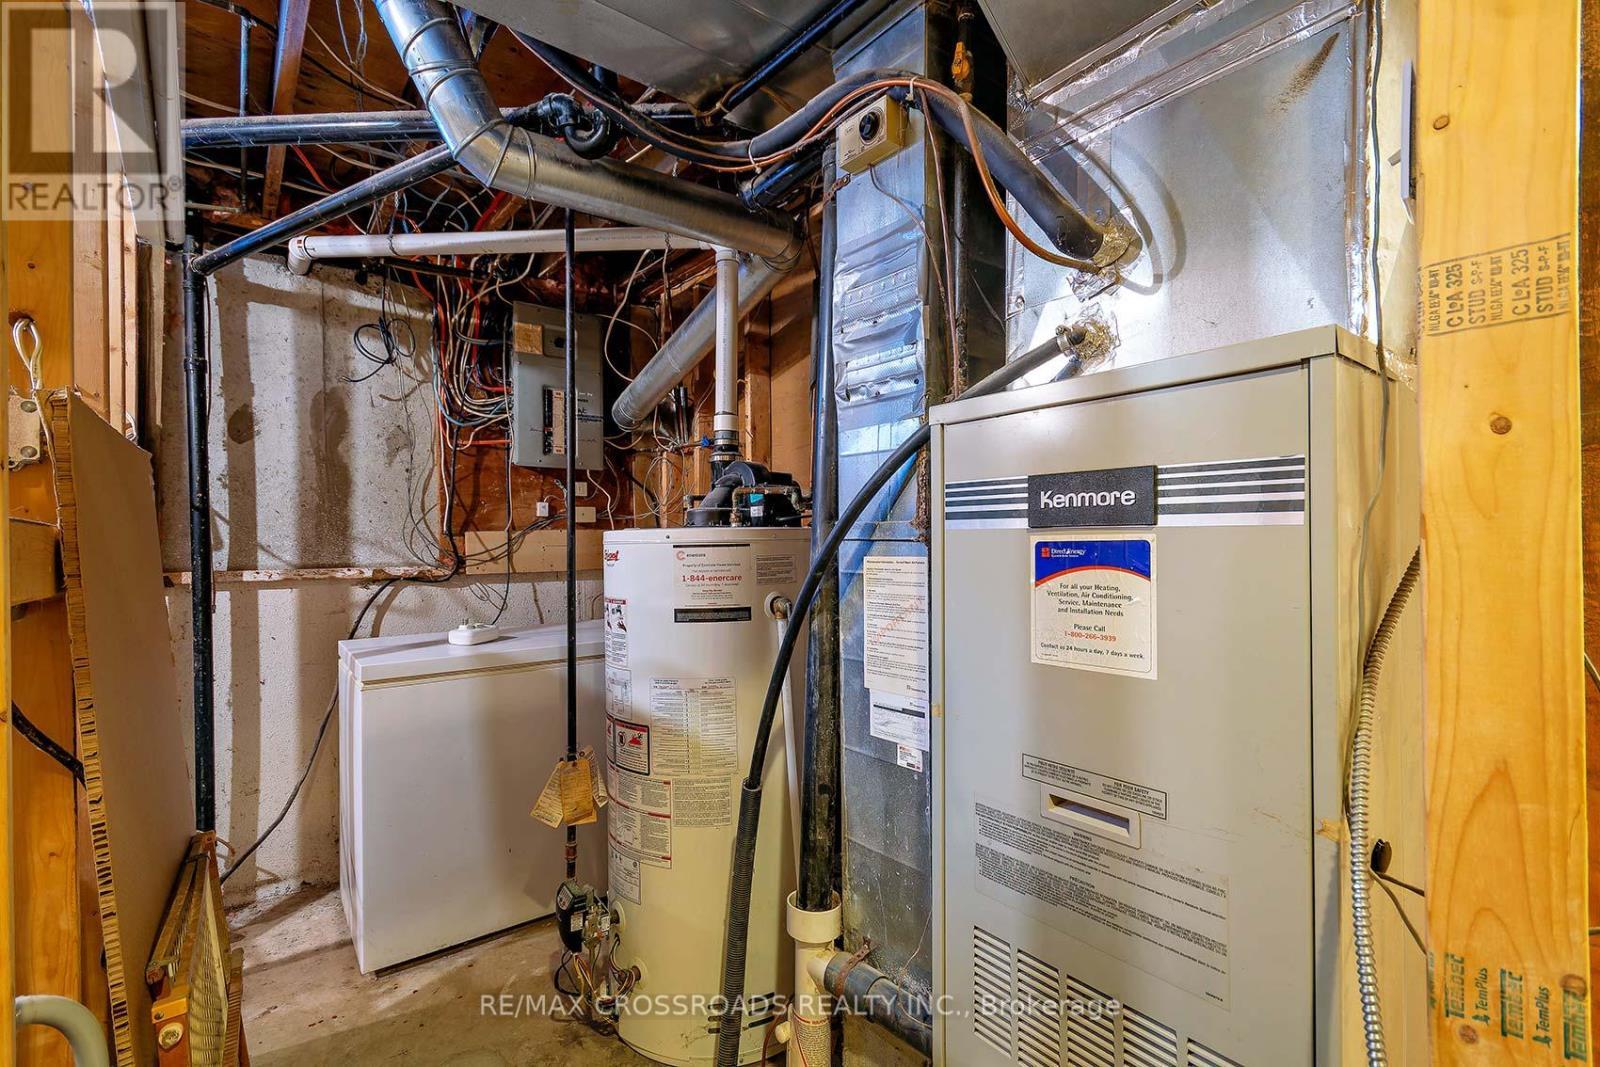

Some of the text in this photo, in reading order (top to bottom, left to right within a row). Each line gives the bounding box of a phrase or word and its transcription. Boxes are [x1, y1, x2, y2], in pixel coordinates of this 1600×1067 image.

[1510, 248, 1529, 274] 325
[1445, 263, 1464, 289] 325
[1536, 276, 1554, 313] STUD
[1468, 288, 1486, 325] STUD
[1040, 490, 1136, 508] Kenmore
[682, 574, 743, 582] 1-844-enercare
[1047, 590, 1080, 598] Ventilation,
[1091, 592, 1133, 601] Conditioning,
[1094, 584, 1121, 592] Heating,
[1059, 598, 1122, 608] Service, Maintenance
[1070, 607, 1103, 615] Installation
[1105, 609, 1124, 617] Needs
[1040, 642, 1058, 650] Contact
[1473, 967, 1488, 1011] TemPlus
[1534, 986, 1551, 1033] TemPlus
